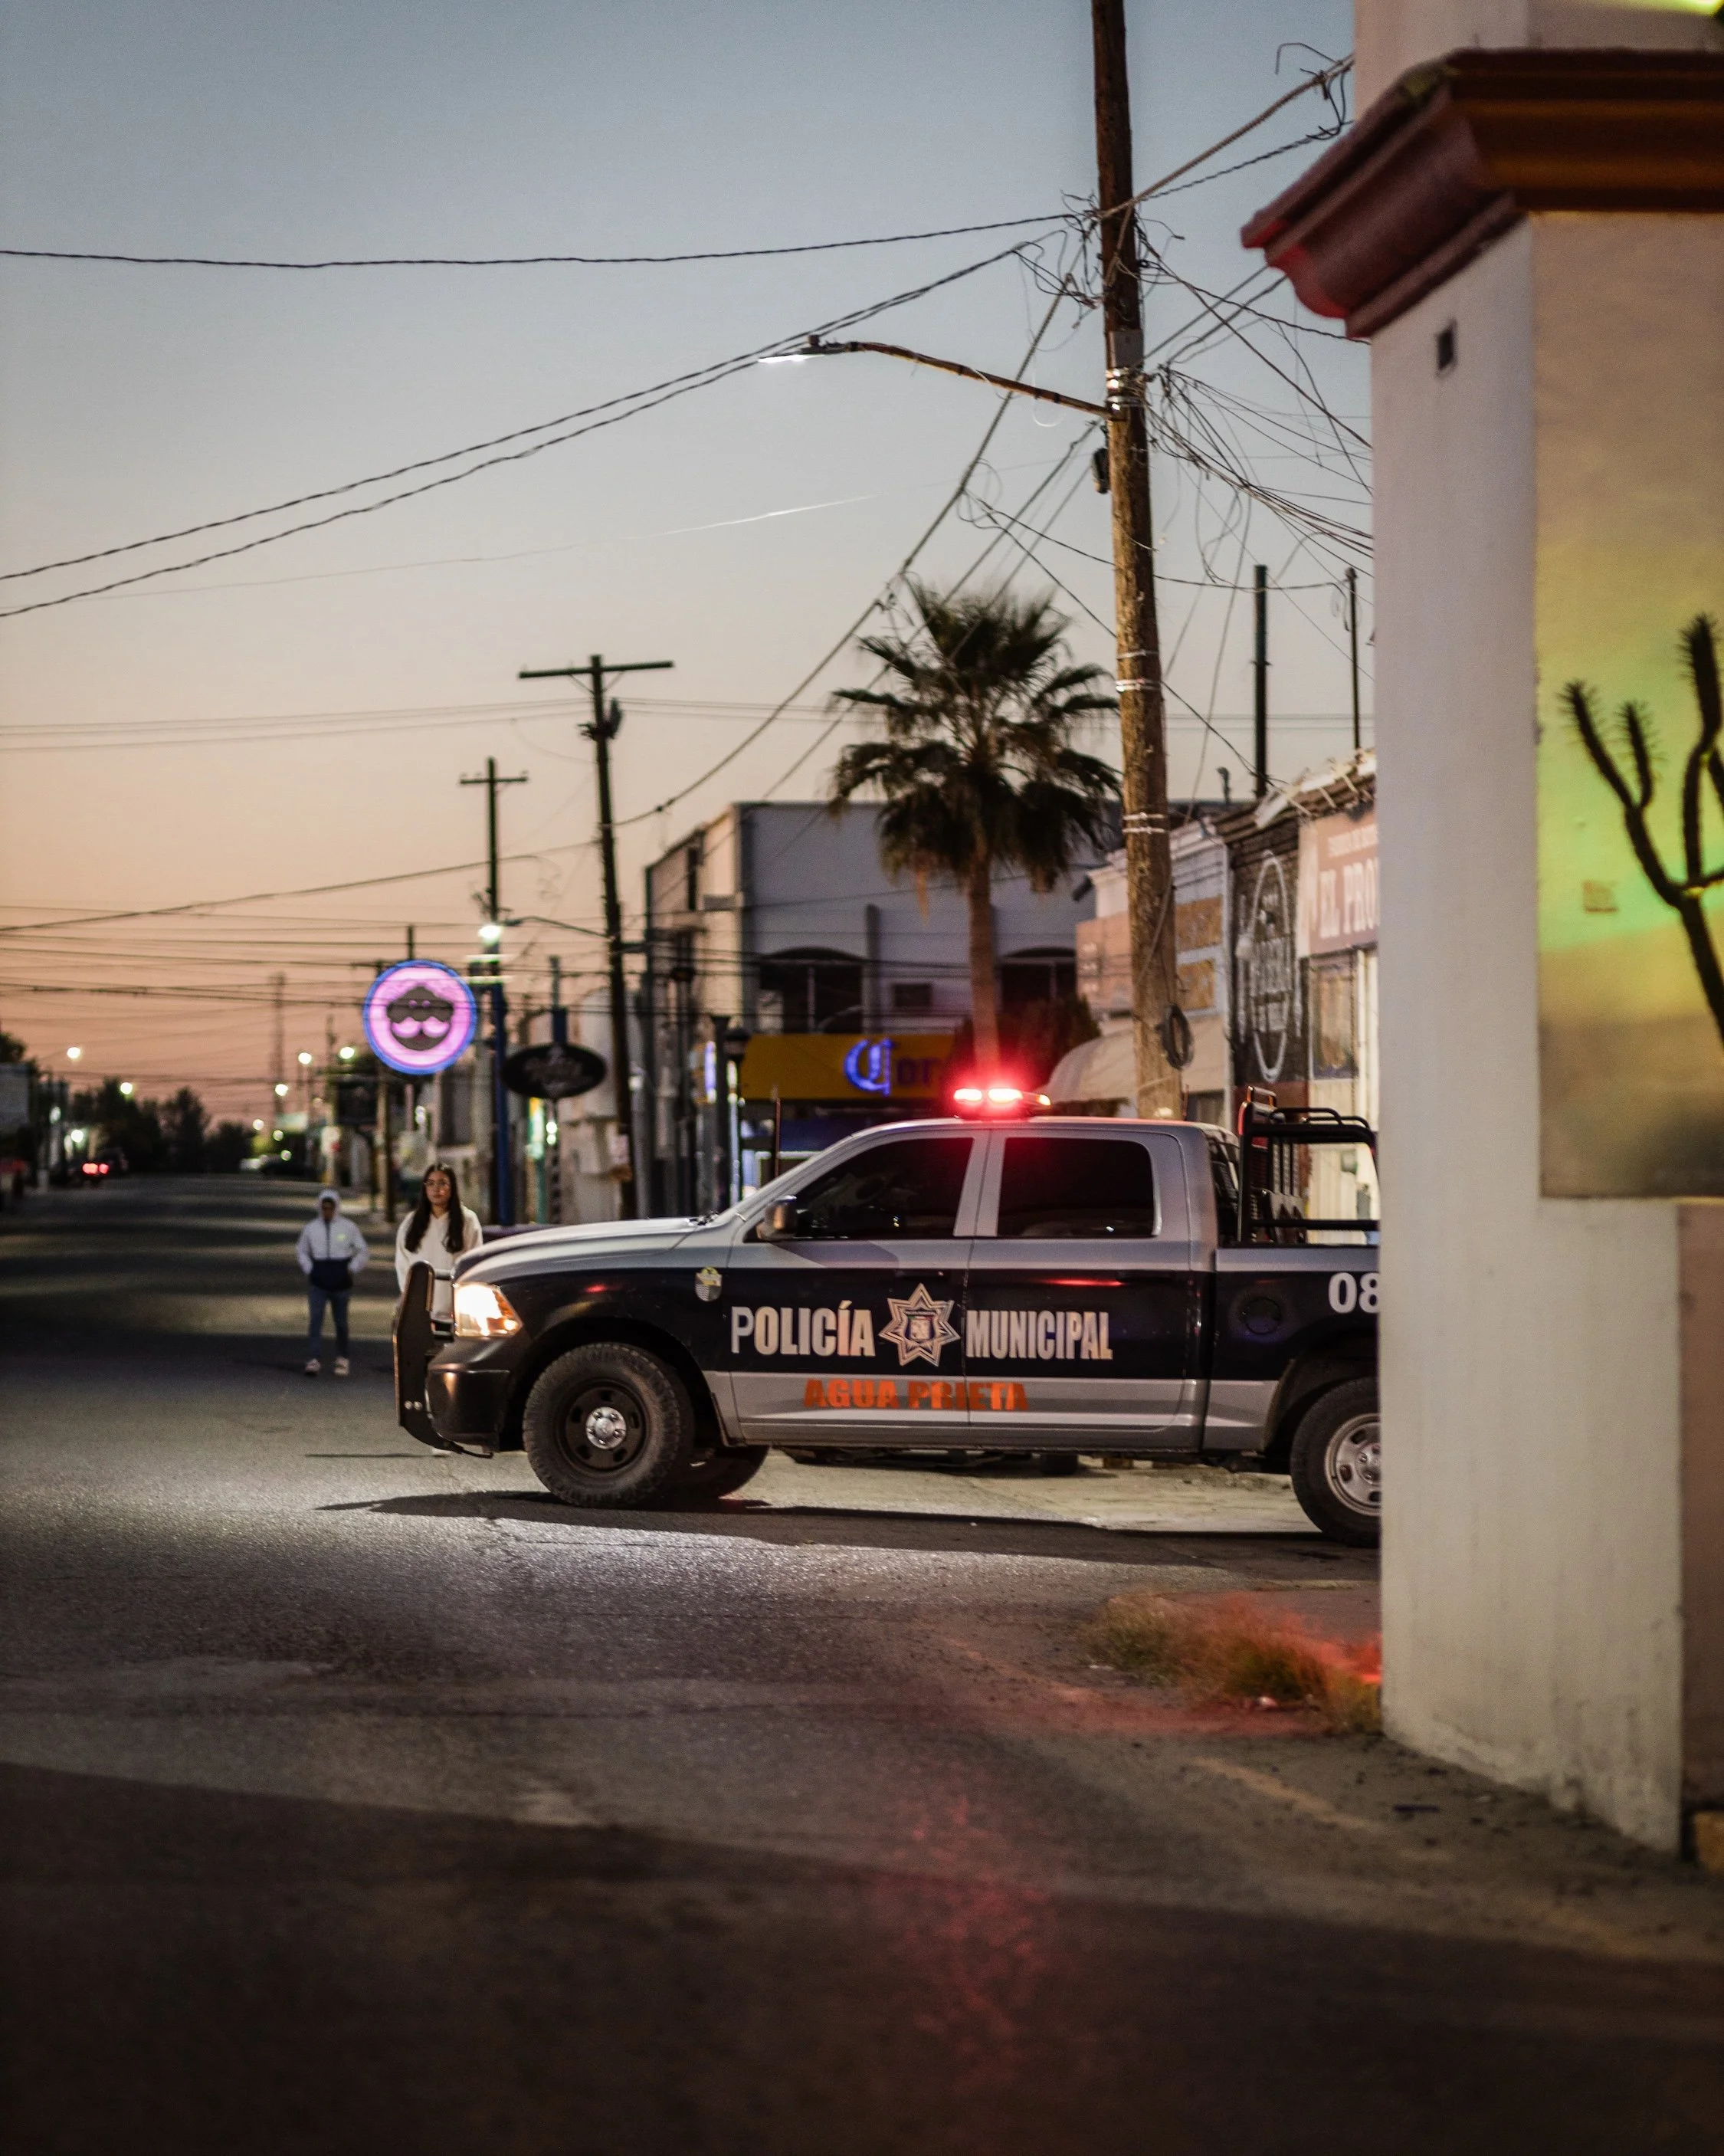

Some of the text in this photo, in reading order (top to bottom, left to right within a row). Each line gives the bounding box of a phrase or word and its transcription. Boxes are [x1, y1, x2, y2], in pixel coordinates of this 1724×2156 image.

[1328, 1272, 1380, 1314] 08
[731, 1299, 1113, 1360] POLICÍA MUNICIPAL
[804, 1378, 1029, 1411] AGUA PRIETA
